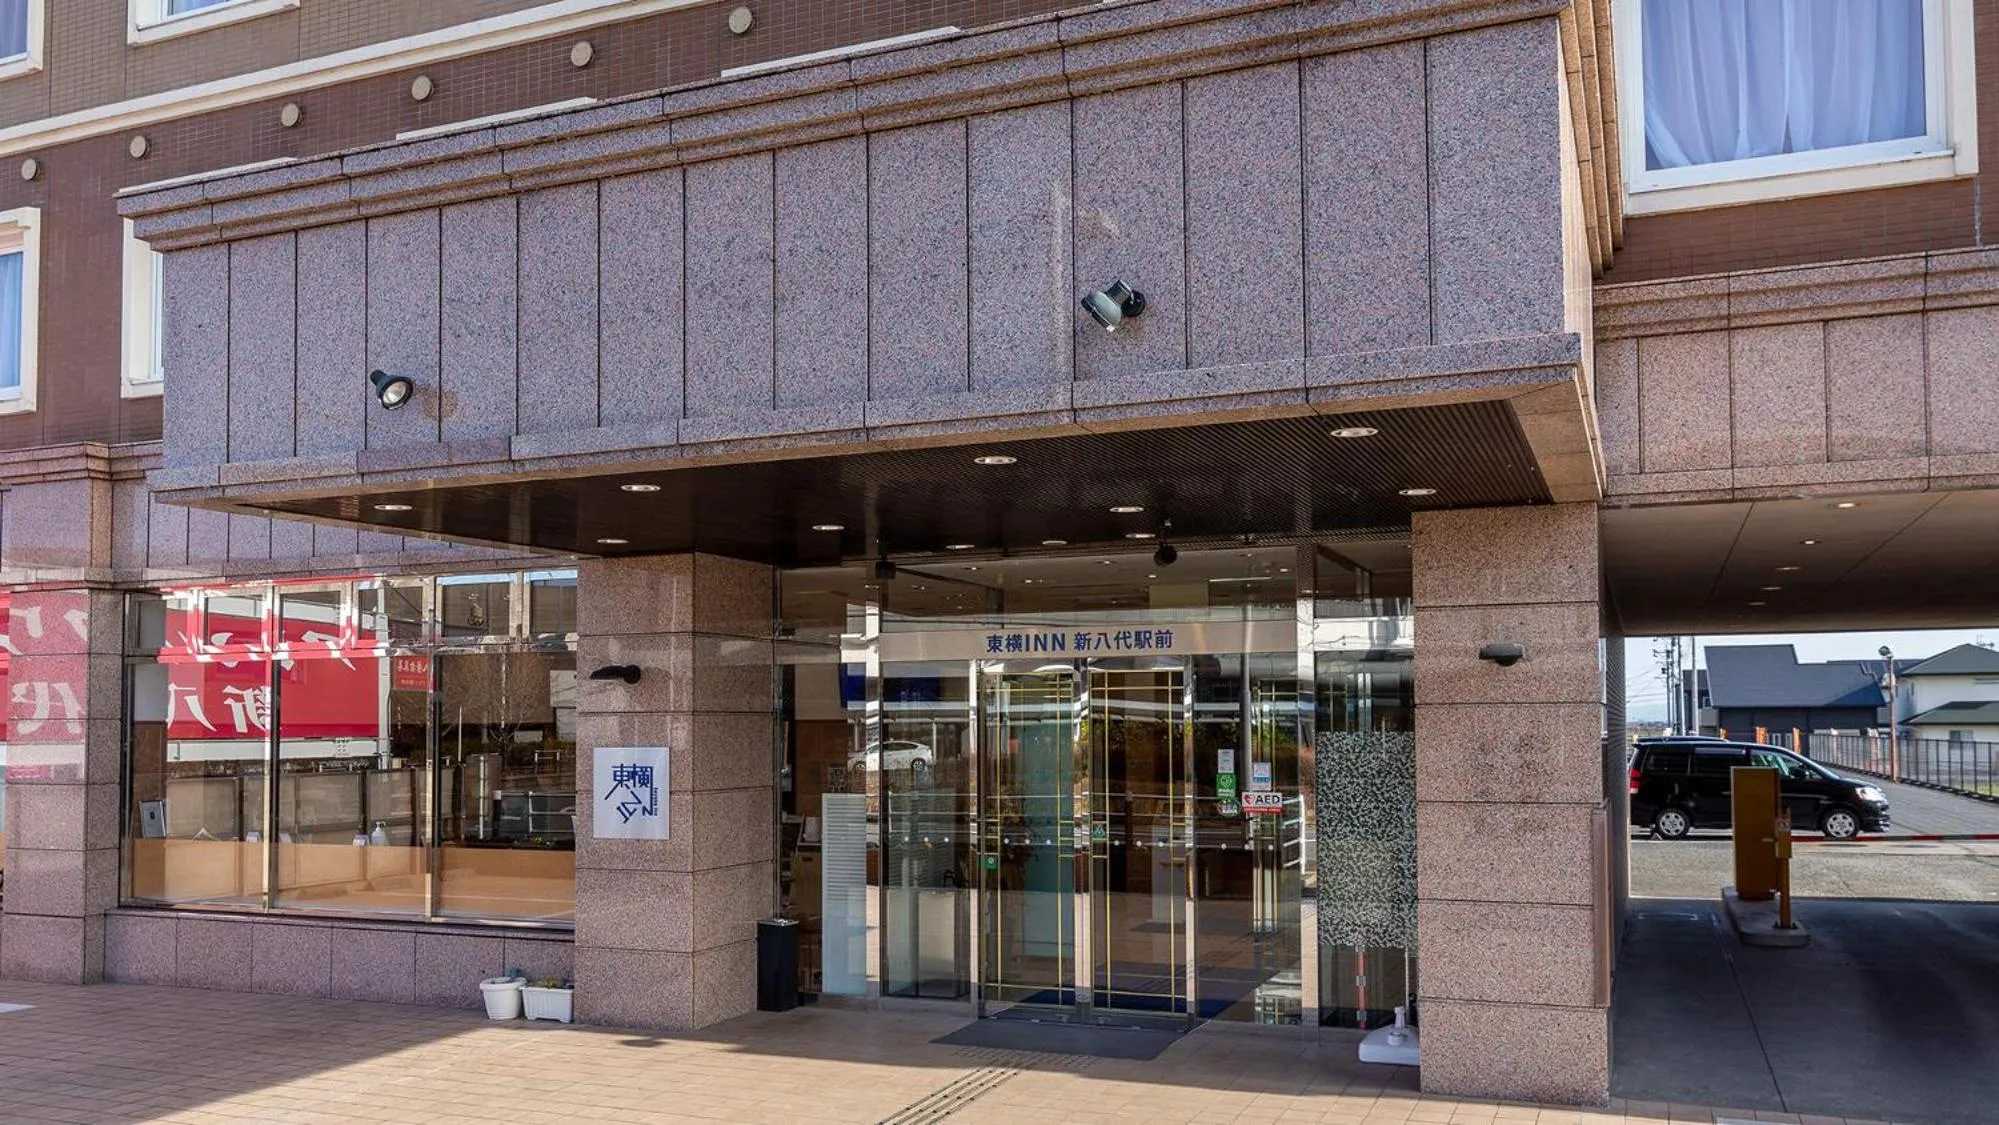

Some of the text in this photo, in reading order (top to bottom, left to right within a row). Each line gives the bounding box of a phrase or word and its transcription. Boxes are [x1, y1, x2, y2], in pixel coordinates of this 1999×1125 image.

[986, 629, 1174, 653] 東横INN 新八代駅前
[1255, 795, 1280, 804] AED
